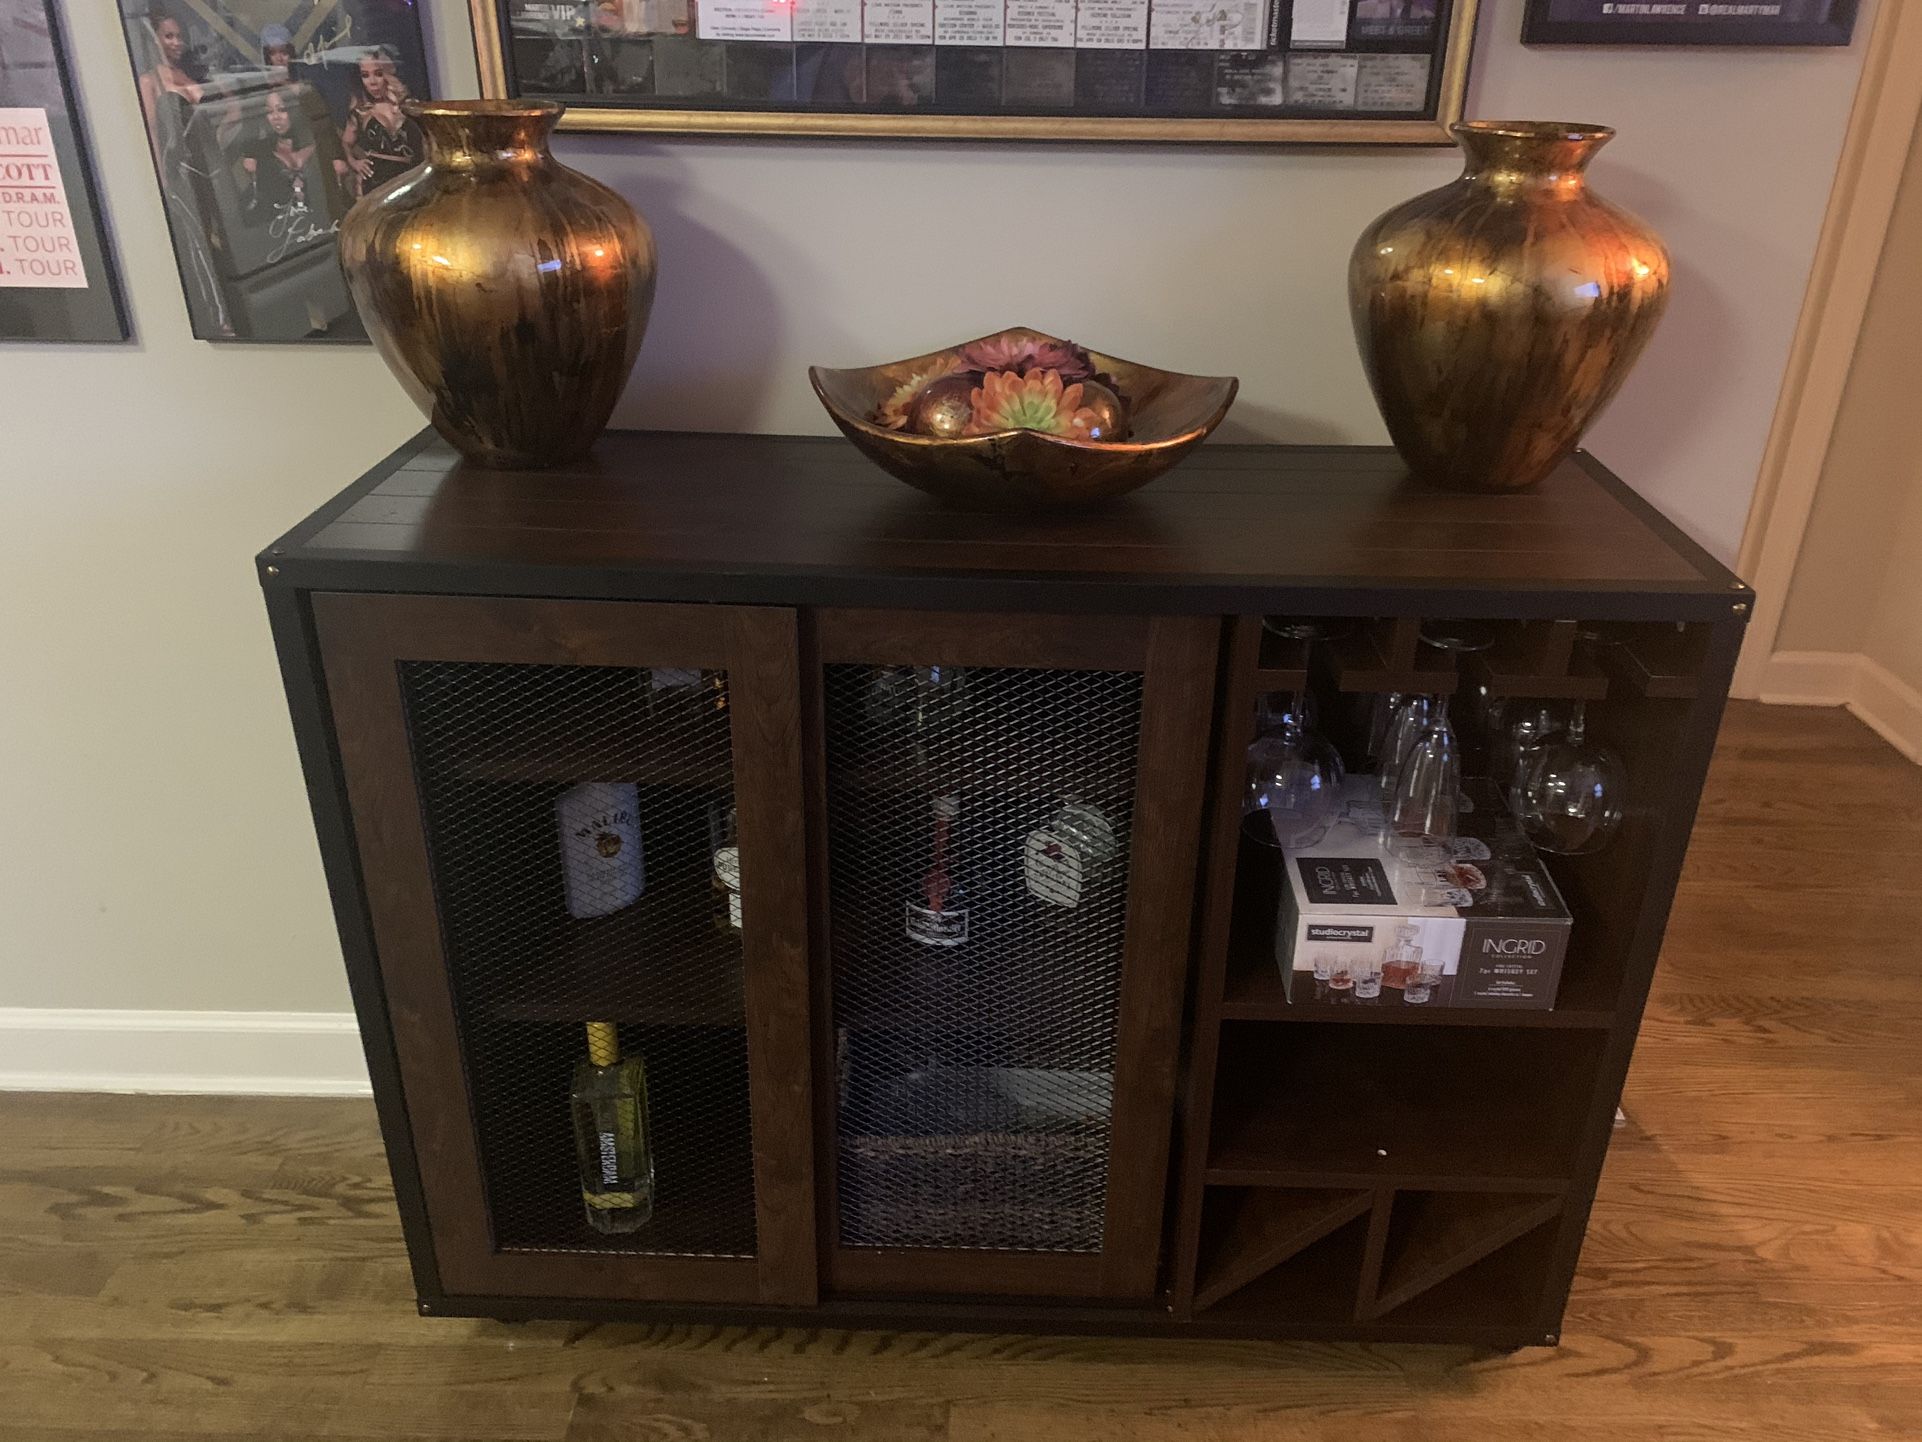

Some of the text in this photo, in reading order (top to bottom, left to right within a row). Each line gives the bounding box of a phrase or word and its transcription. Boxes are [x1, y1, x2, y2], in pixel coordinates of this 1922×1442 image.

[550, 4, 576, 20] VIP
[2, 191, 60, 204] D.R.A.M.
[3, 210, 66, 228] TOUR
[8, 235, 73, 253] TOUR
[15, 258, 78, 276] TOUR
[1311, 928, 1369, 939] studiocrystal
[1482, 938, 1546, 954] INGRID
[599, 1132, 618, 1184] AMSTERDAM
